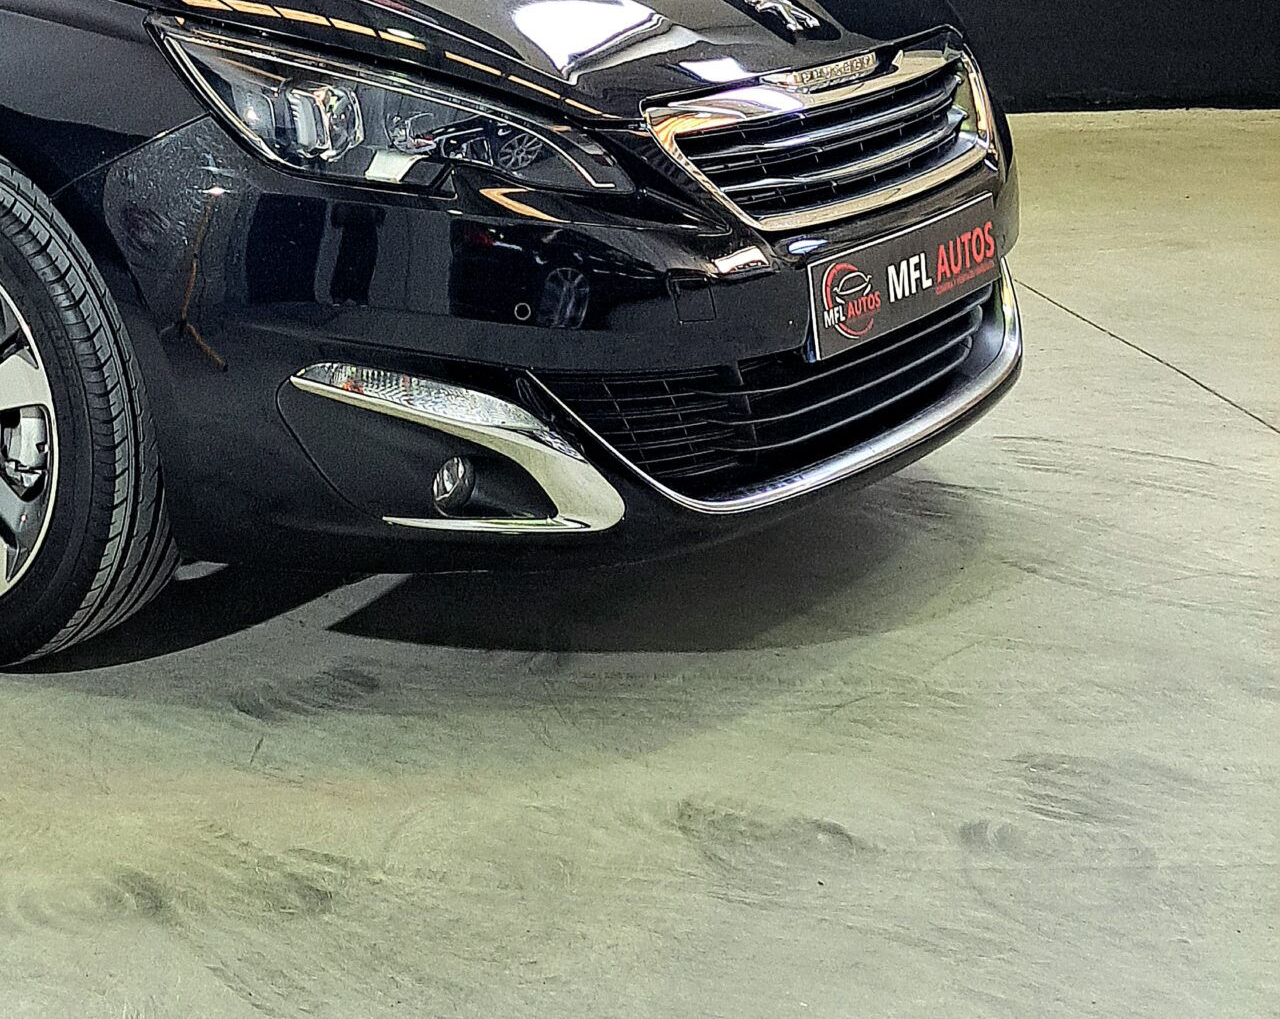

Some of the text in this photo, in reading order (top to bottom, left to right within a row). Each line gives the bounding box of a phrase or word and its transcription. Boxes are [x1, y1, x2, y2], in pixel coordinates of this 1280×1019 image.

[887, 252, 933, 303] MFL
[936, 221, 996, 283] AUTOS
[823, 305, 847, 329] MFL
[847, 291, 882, 319] AUTOS
